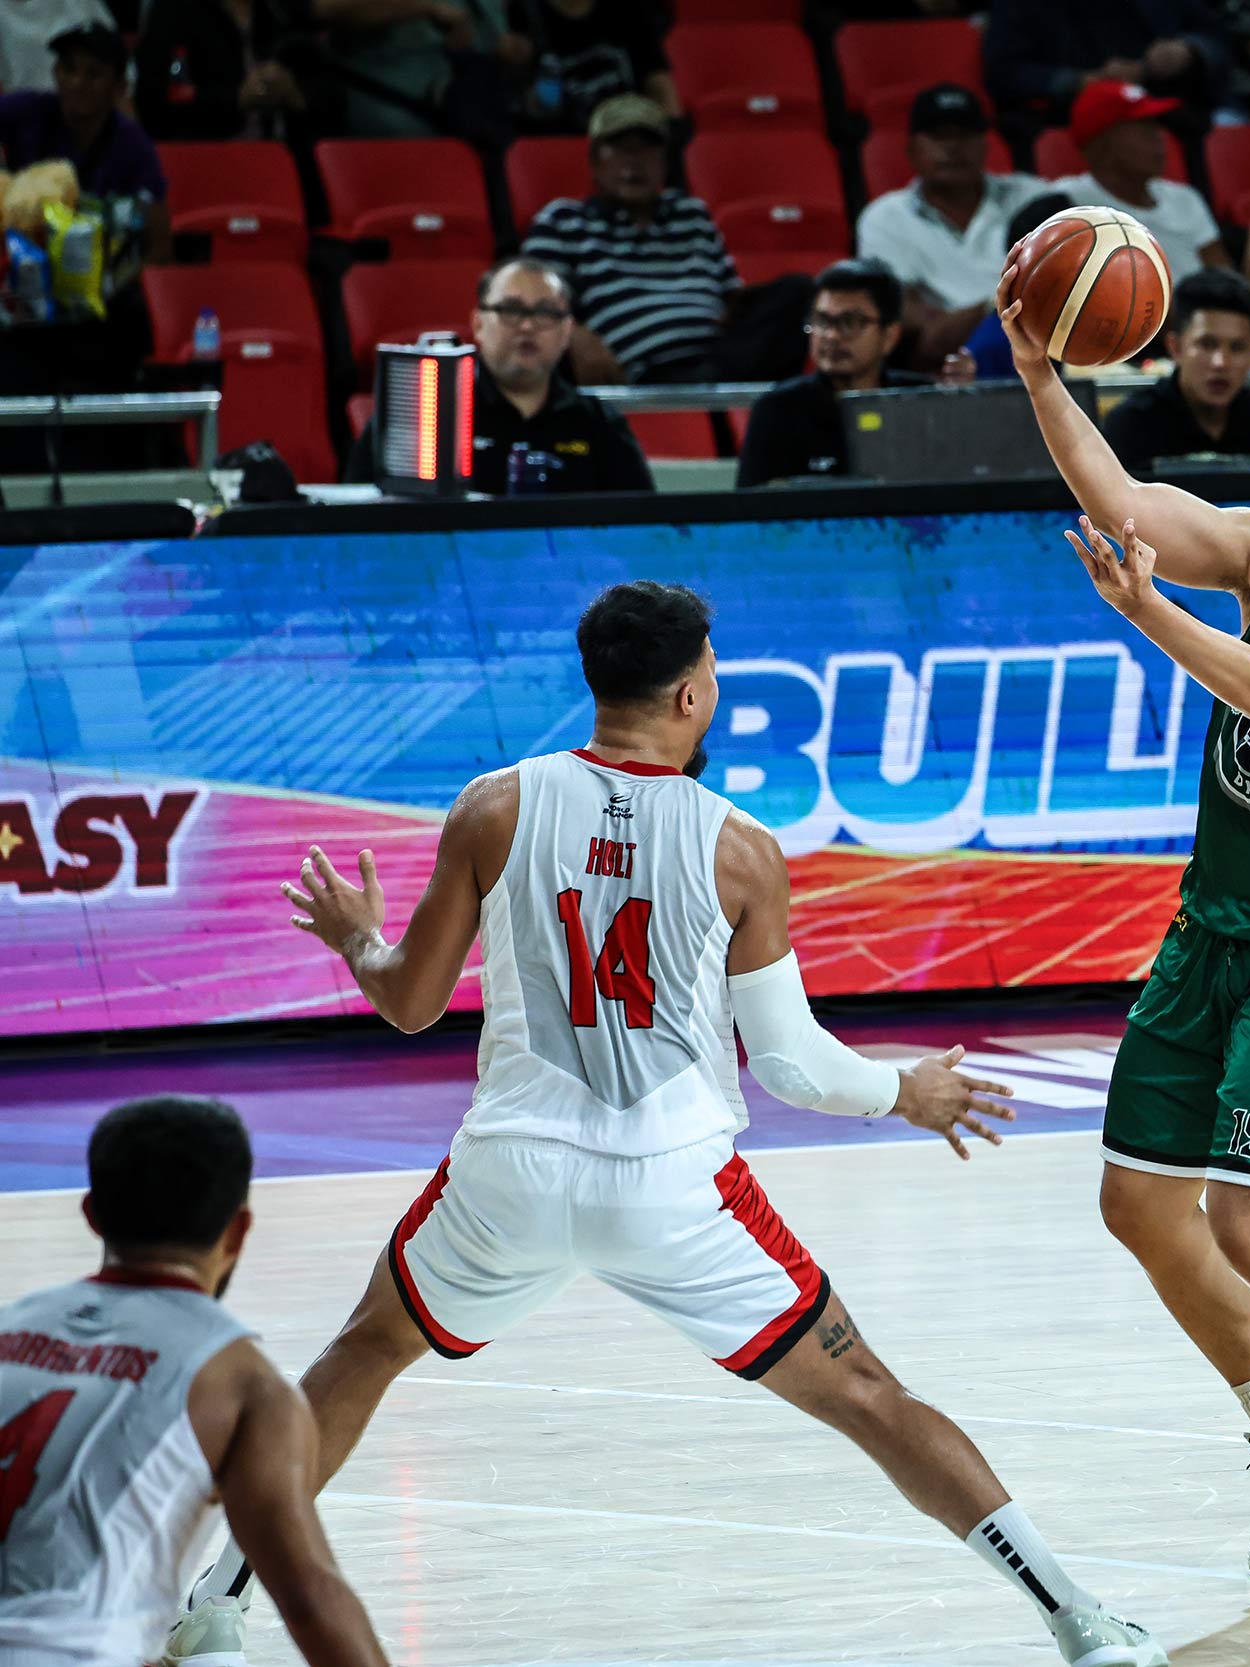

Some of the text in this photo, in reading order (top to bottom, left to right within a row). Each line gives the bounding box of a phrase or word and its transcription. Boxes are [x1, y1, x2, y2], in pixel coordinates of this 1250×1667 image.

[714, 648, 1196, 842] BUIL
[585, 837, 637, 879] HOLT
[557, 887, 655, 1029] 14
